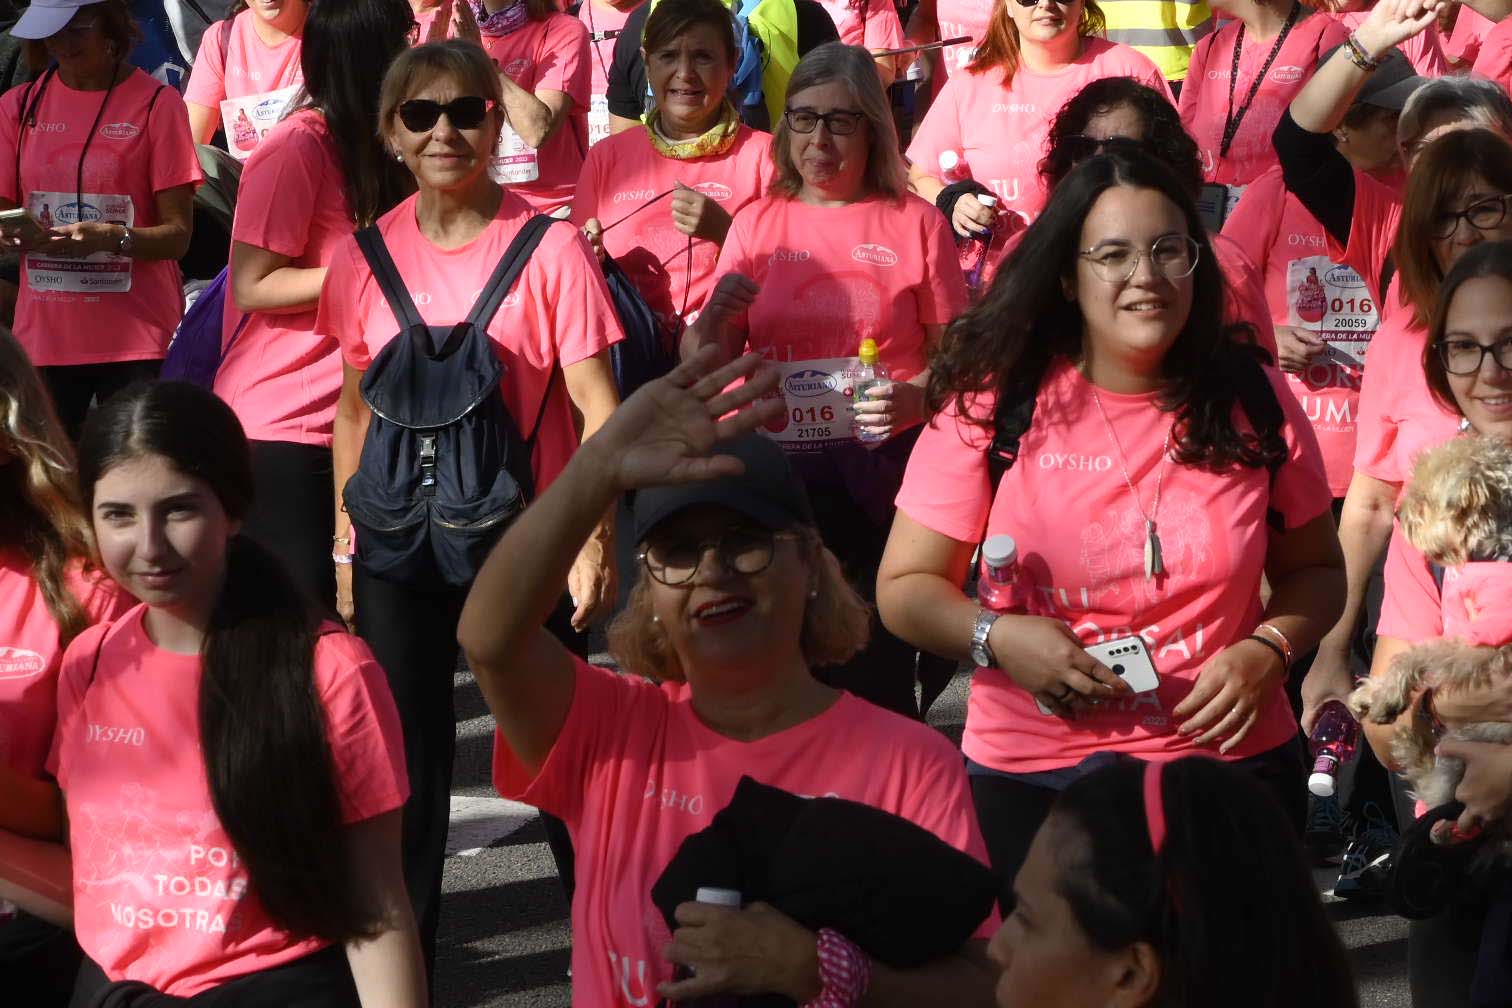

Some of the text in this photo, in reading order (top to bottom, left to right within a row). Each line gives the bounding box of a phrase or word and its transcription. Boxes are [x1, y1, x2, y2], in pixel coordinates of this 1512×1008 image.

[613, 189, 655, 204] OYSHO
[1288, 233, 1325, 248] OYSH
[853, 250, 896, 265] ASTURIANA
[34, 274, 63, 285] OYSHO
[1331, 298, 1372, 314] 016
[1334, 318, 1367, 328] 20059
[1337, 332, 1348, 340] DE
[1349, 332, 1359, 340] LA
[788, 379, 833, 392] ASTURIANA
[791, 406, 834, 423] 016
[797, 427, 832, 438] 21705
[1039, 453, 1113, 472] OYSHO
[155, 875, 248, 900] TODAS
[110, 903, 241, 934] NOSOTRA
